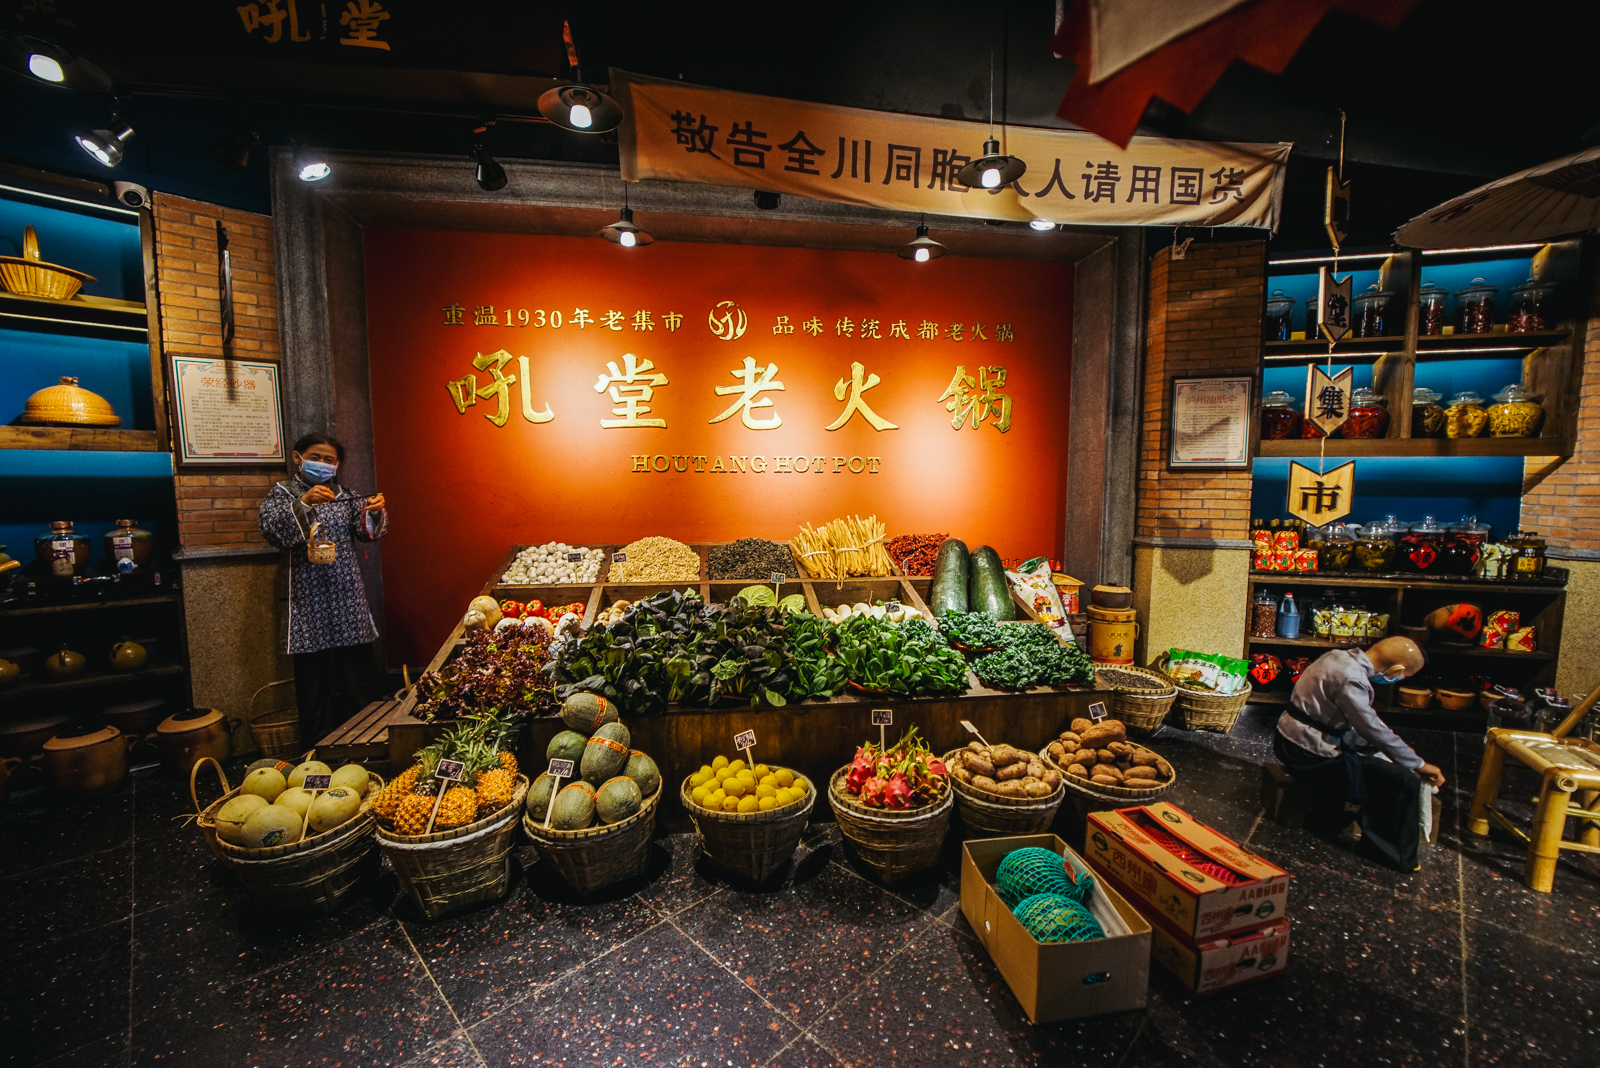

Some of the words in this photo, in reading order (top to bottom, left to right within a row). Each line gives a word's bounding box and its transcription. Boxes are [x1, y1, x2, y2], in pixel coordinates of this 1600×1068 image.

[441, 303, 685, 333] 重温1930年老集市
[771, 315, 1016, 344] 品味传统成都老火锅
[446, 348, 1013, 433] 吼堂老火锅
[1317, 385, 1344, 419] 集
[631, 454, 767, 474] HOUTANG
[774, 455, 826, 474] HOT
[832, 456, 881, 474] POT
[1300, 480, 1342, 515] 市
